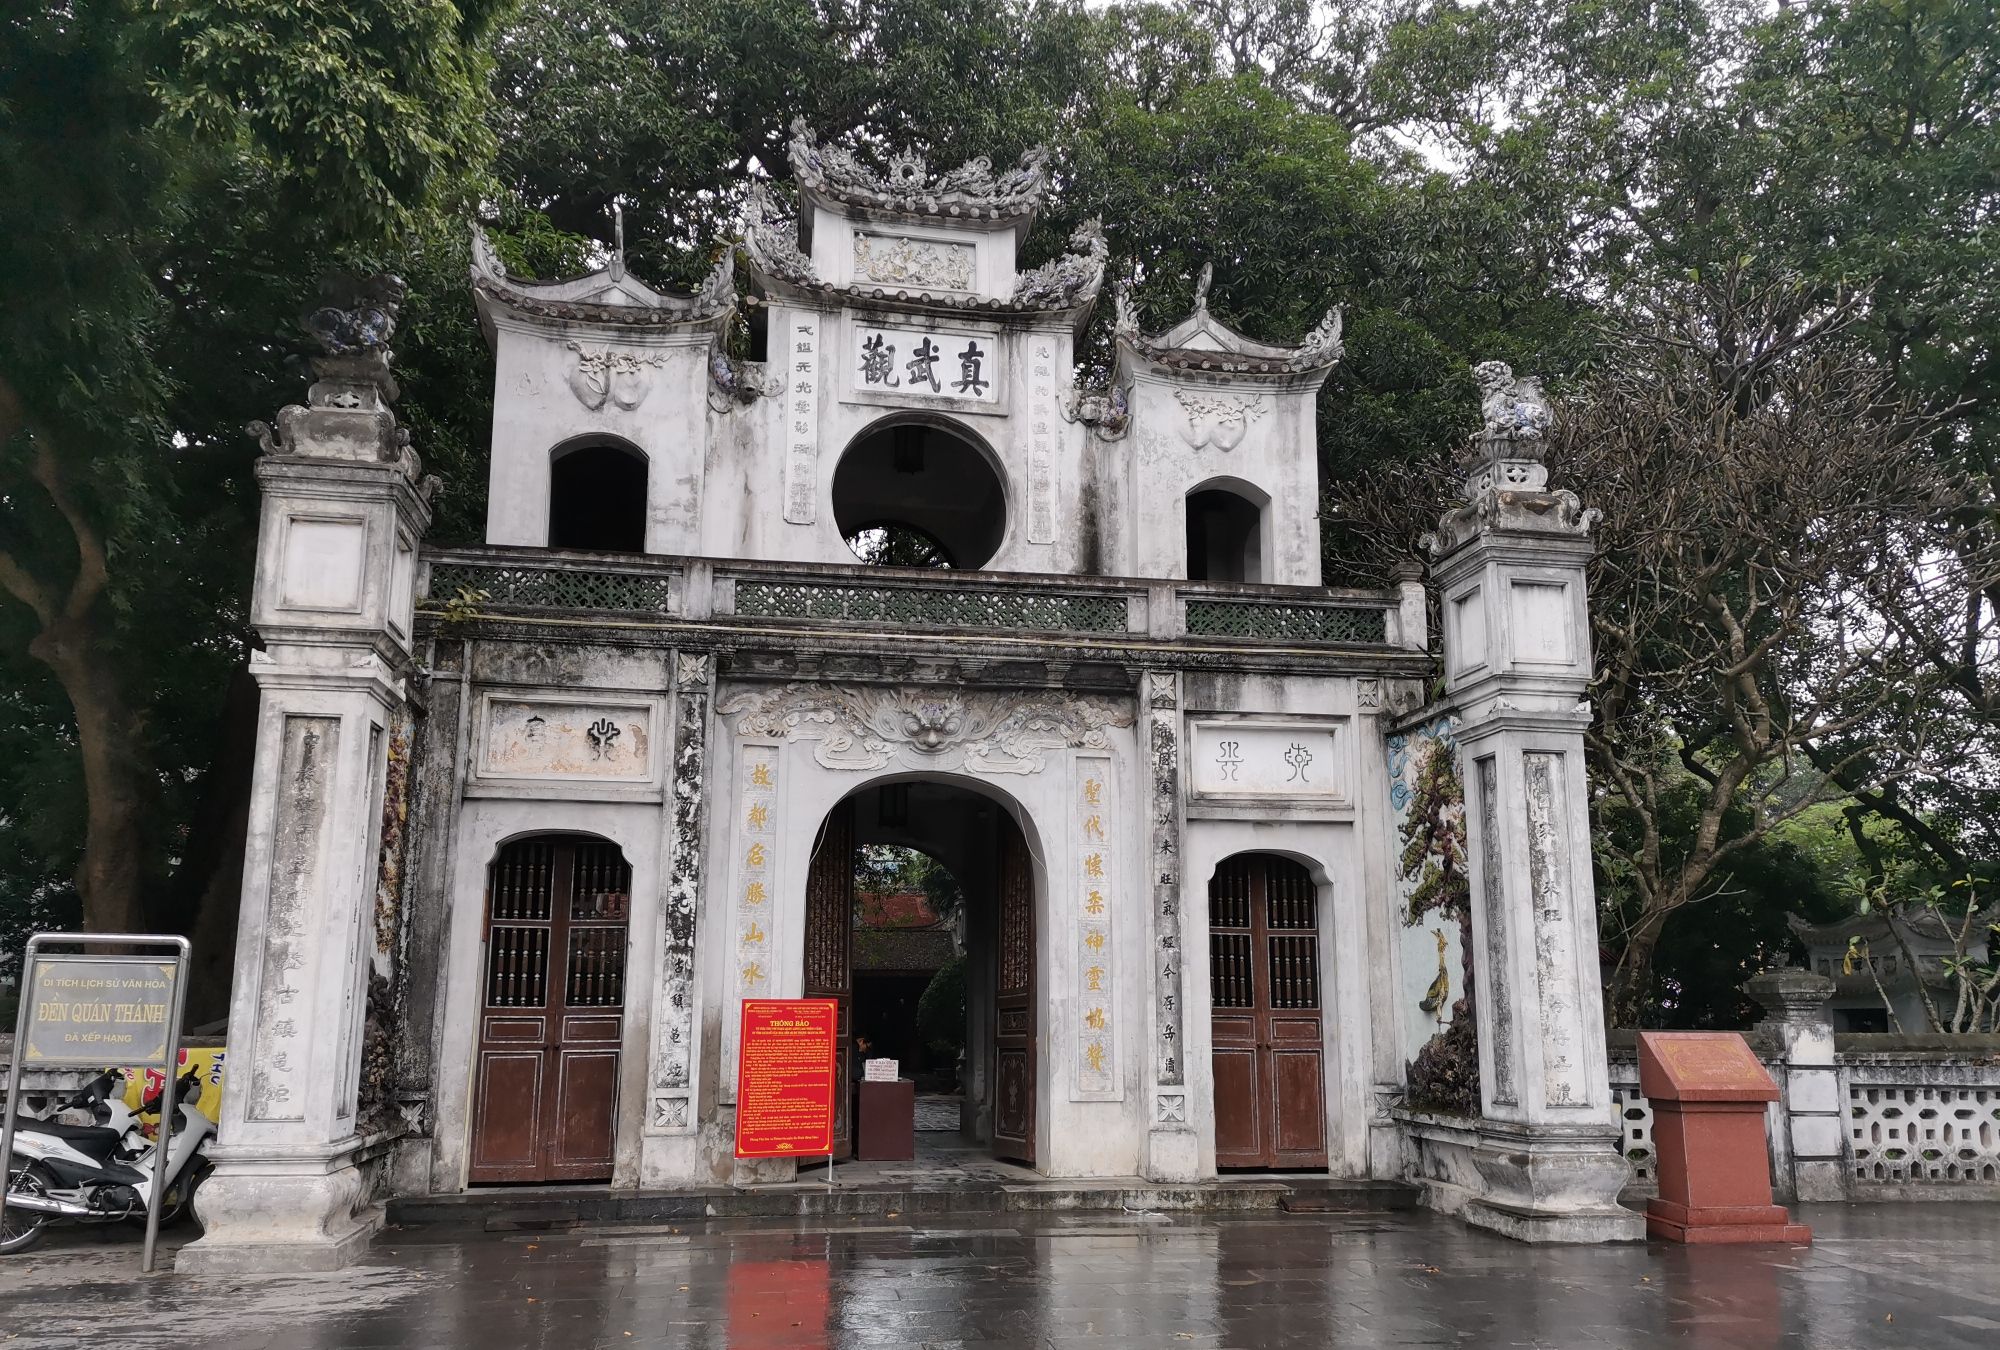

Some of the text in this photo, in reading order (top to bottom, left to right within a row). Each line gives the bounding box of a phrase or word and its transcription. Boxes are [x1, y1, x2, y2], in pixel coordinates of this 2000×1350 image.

[43, 979, 54, 987] DI
[57, 977, 78, 988] TÍCH
[80, 979, 104, 990] LỊCH
[122, 978, 142, 988] VĂN
[38, 991, 166, 1024] ĐỀN QUÁN THÁNH
[795, 1017, 810, 1027] BÁO
[64, 1031, 133, 1045] ĐÃ XẾP HẠNG
